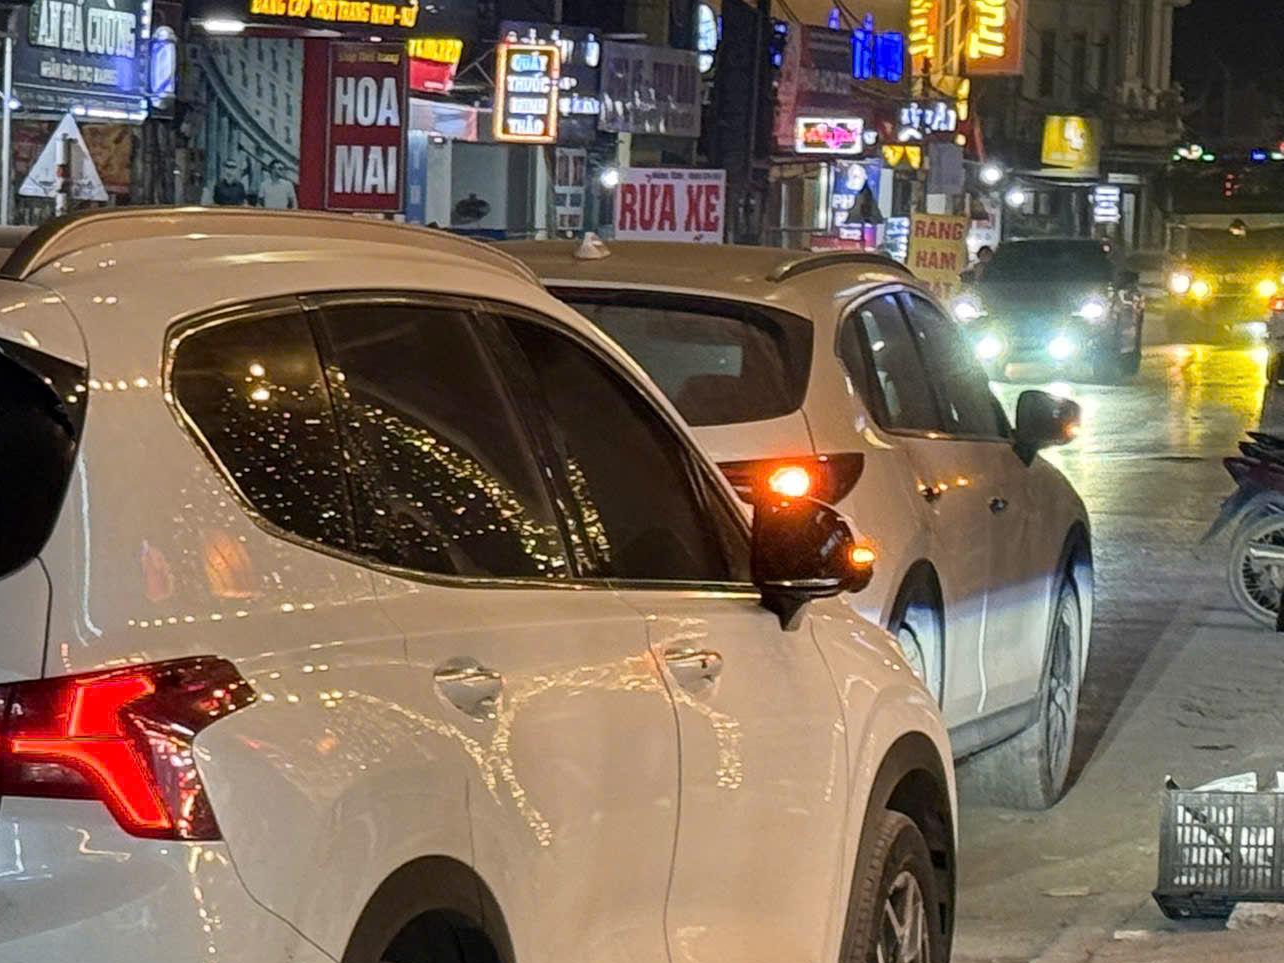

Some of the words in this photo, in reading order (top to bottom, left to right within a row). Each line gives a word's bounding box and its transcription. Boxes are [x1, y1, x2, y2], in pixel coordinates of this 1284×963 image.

[334, 76, 401, 127] HOA
[333, 144, 400, 195] MAI
[683, 183, 720, 233] XE
